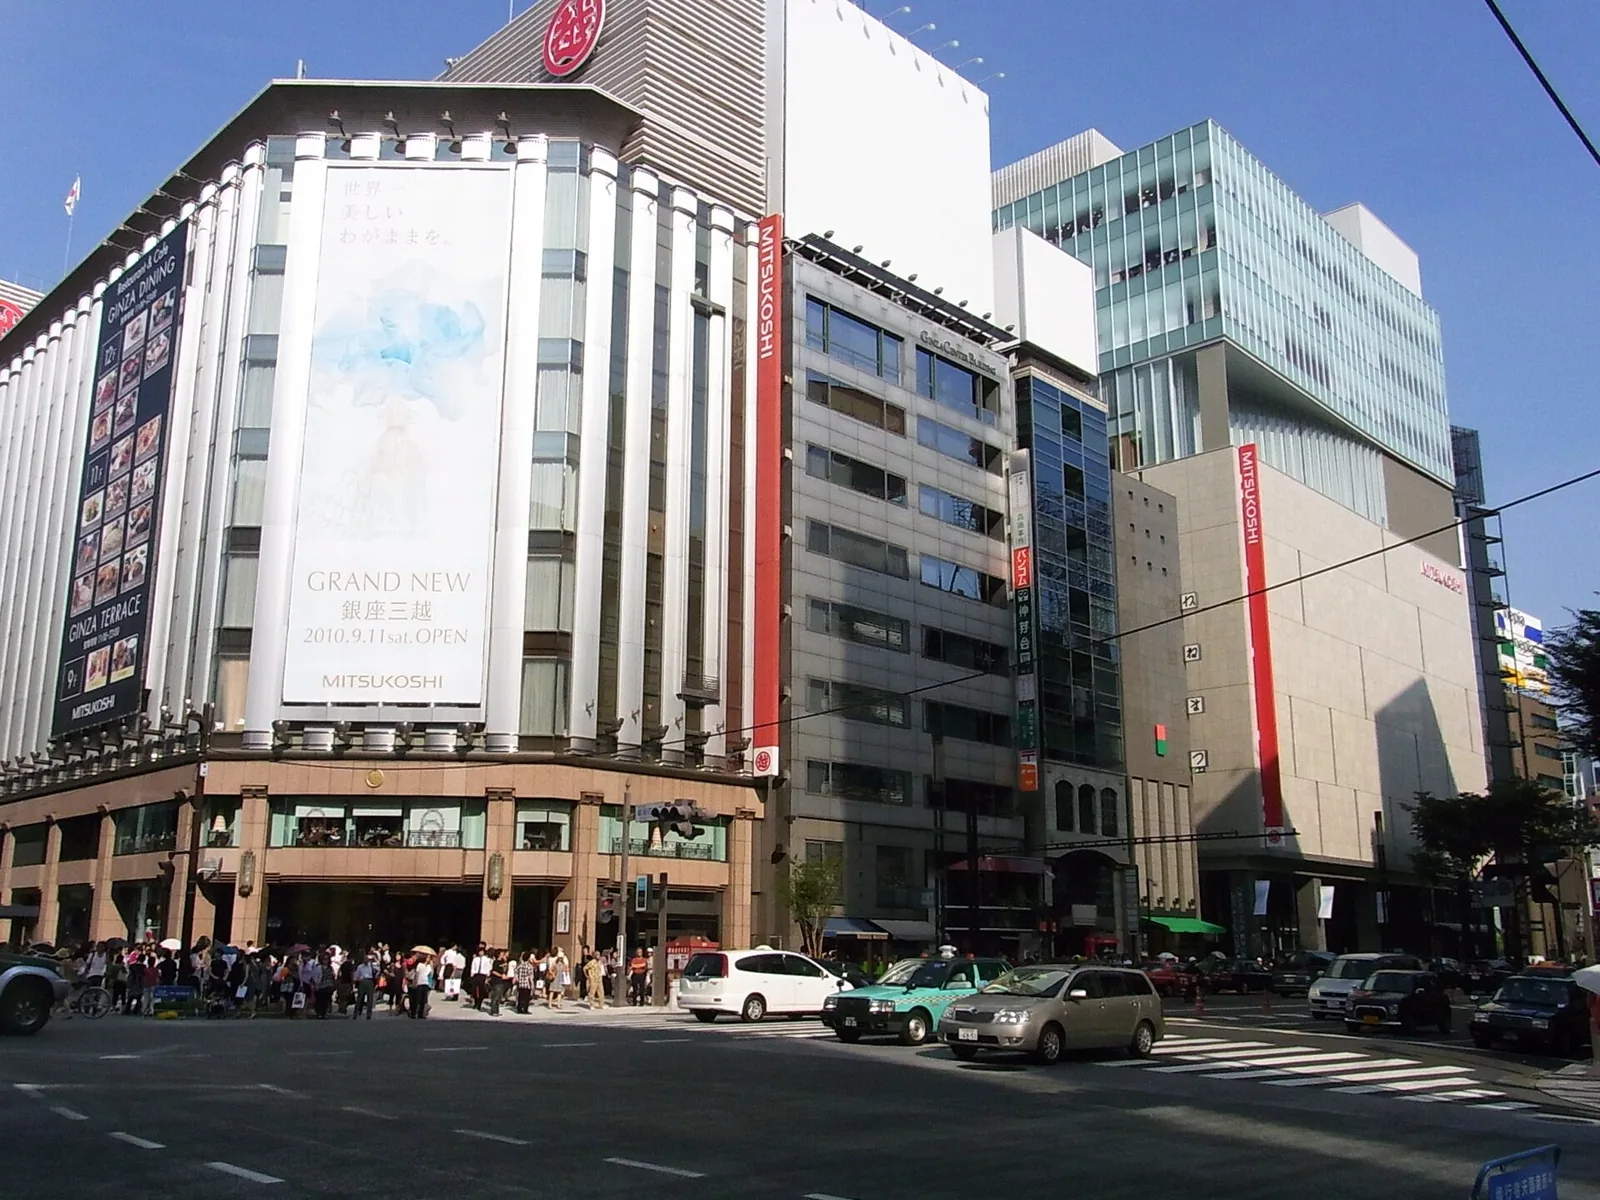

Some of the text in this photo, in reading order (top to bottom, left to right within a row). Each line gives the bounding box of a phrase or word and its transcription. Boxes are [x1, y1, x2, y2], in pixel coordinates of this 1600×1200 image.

[341, 204, 404, 221] 美しい
[107, 289, 136, 324] GINZA
[138, 255, 176, 298] DINING
[761, 225, 774, 359] MITSUKOSHI
[1242, 451, 1259, 545] MITSUKOSHI
[307, 570, 471, 593] GRAND NEW
[68, 593, 142, 643] GINZA TERRACE
[341, 600, 433, 621] 銀座三越
[322, 675, 443, 689] MITSUKOSHI
[71, 694, 116, 721] MITSUKOSHI
